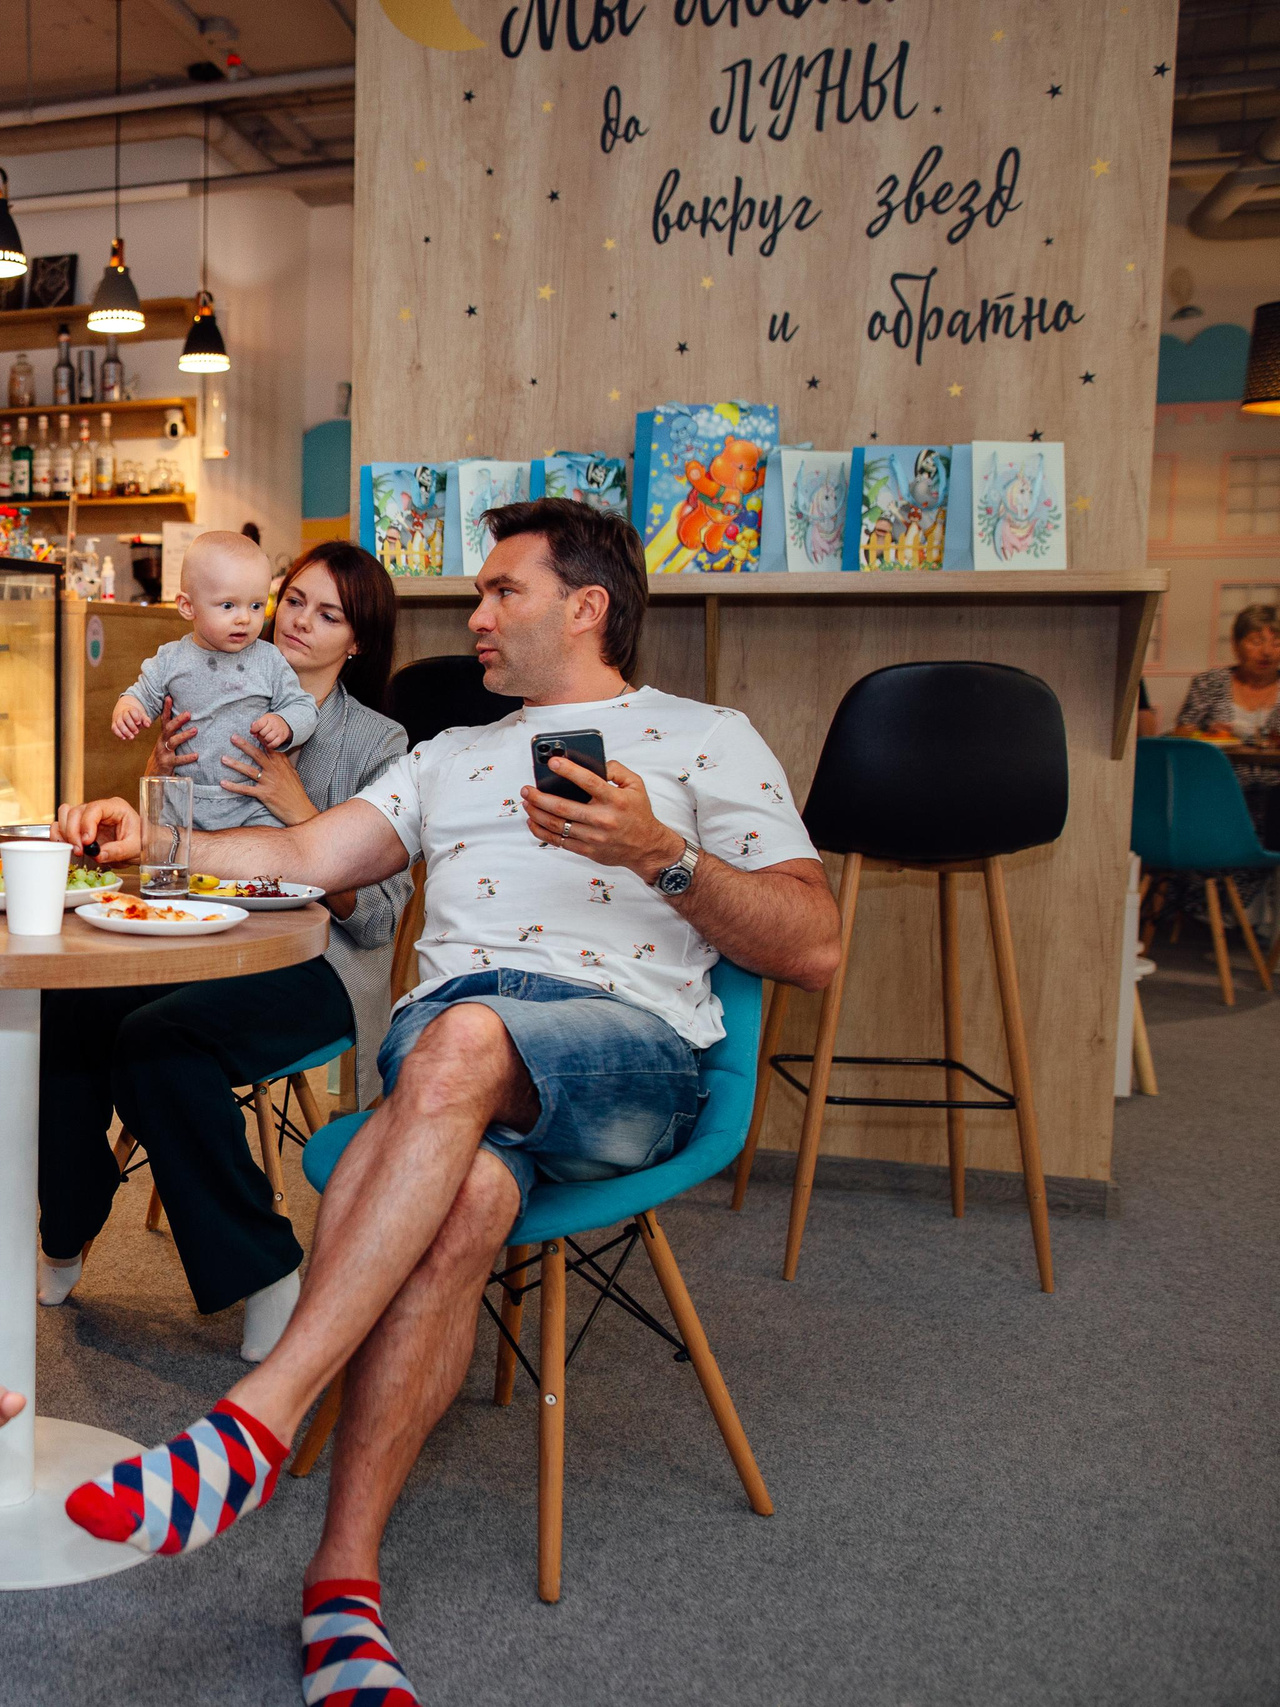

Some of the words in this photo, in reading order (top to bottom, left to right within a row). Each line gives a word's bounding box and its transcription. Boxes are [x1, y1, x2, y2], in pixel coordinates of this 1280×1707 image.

[600, 85, 650, 154] до
[652, 168, 822, 257] вокруг
[866, 145, 1022, 245] звезд
[768, 311, 799, 342] и
[867, 266, 1086, 366] обратно
